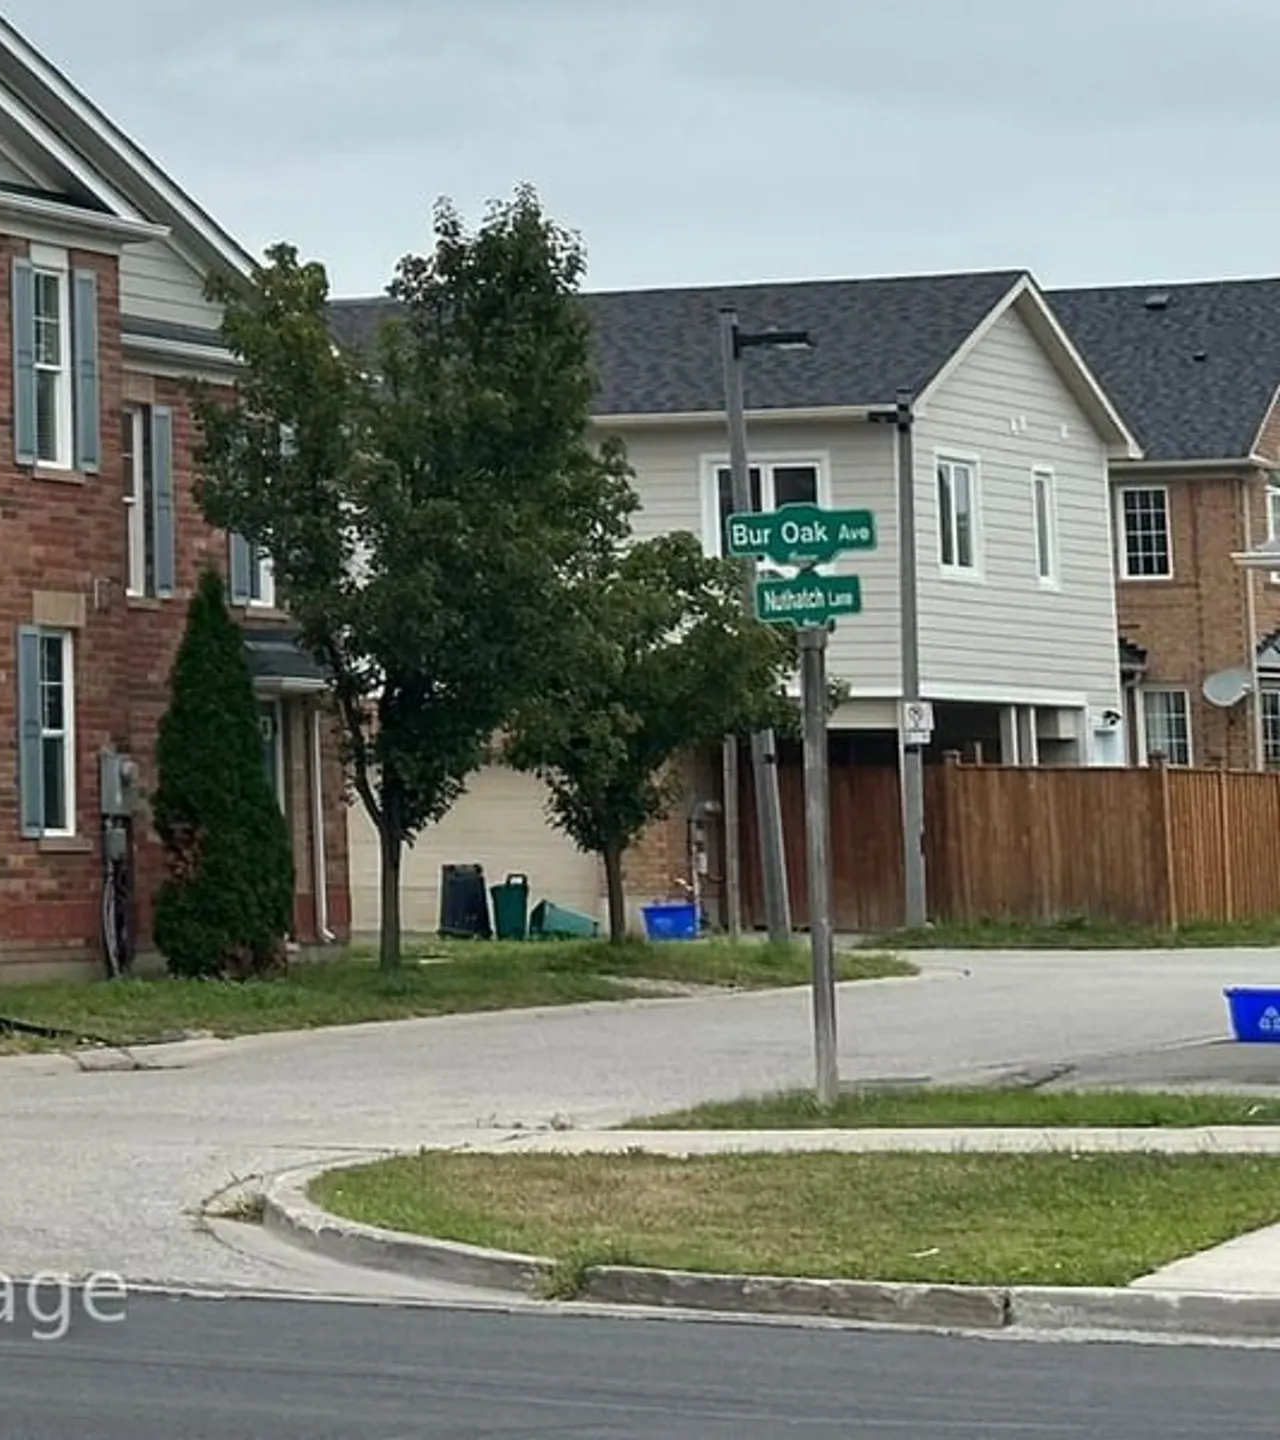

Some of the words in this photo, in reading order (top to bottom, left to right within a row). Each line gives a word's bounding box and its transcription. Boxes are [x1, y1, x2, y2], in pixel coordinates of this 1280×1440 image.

[732, 524, 771, 546] Bur
[781, 521, 828, 544] Oak
[838, 524, 870, 541] Ave
